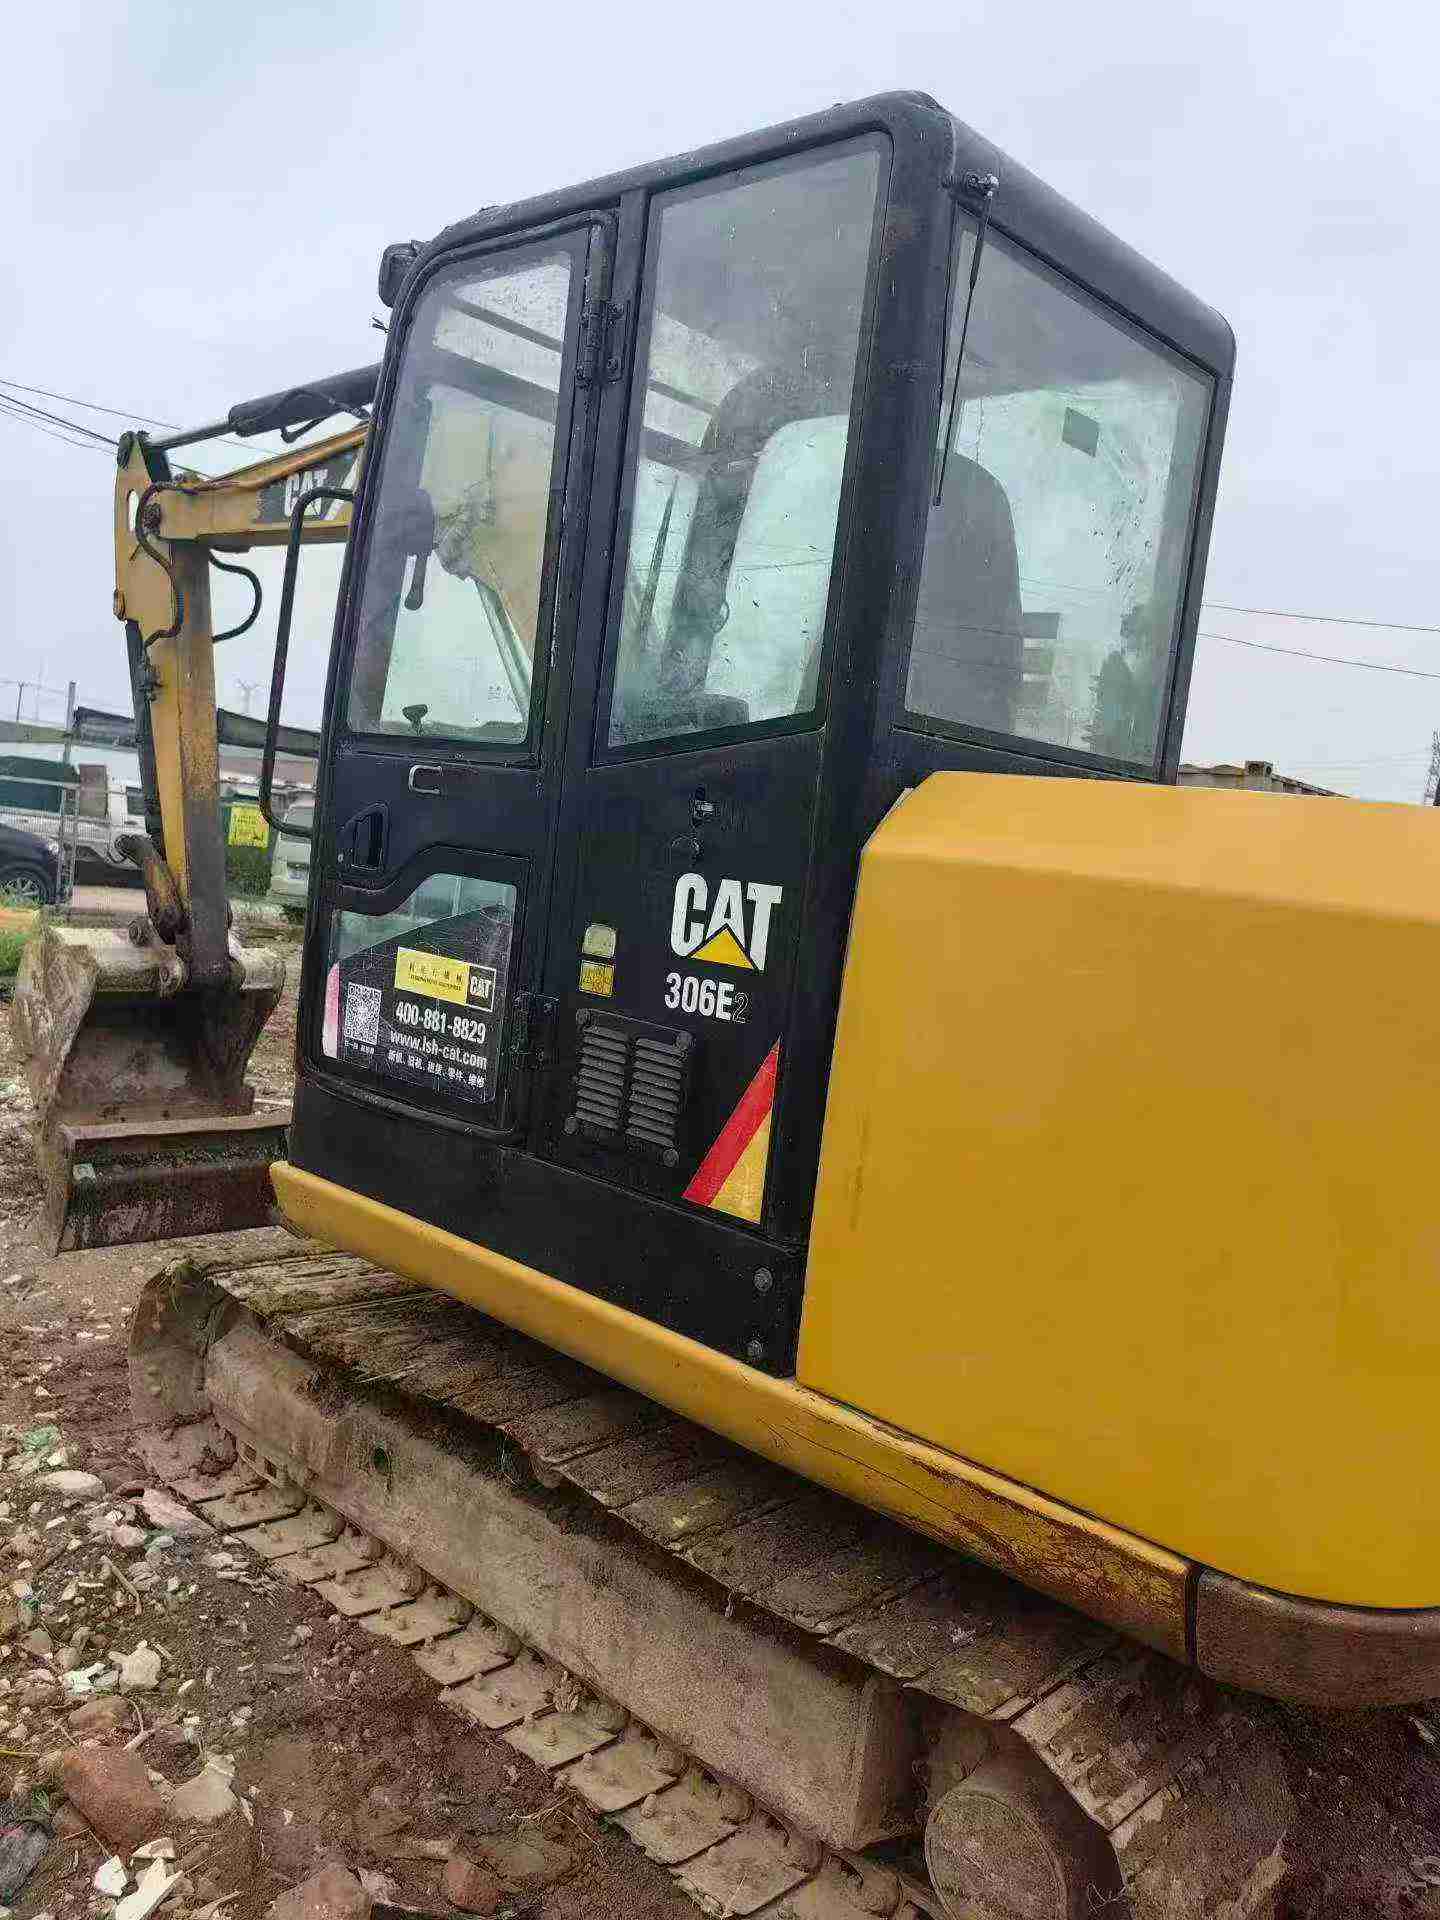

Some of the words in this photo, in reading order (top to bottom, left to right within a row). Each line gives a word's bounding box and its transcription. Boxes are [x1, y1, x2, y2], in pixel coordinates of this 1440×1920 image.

[671, 873, 783, 971] CAT
[469, 975, 491, 999] CAT
[396, 1001, 486, 1044] 400-881-8829
[390, 1030, 488, 1070] www.lsh-cat.com
